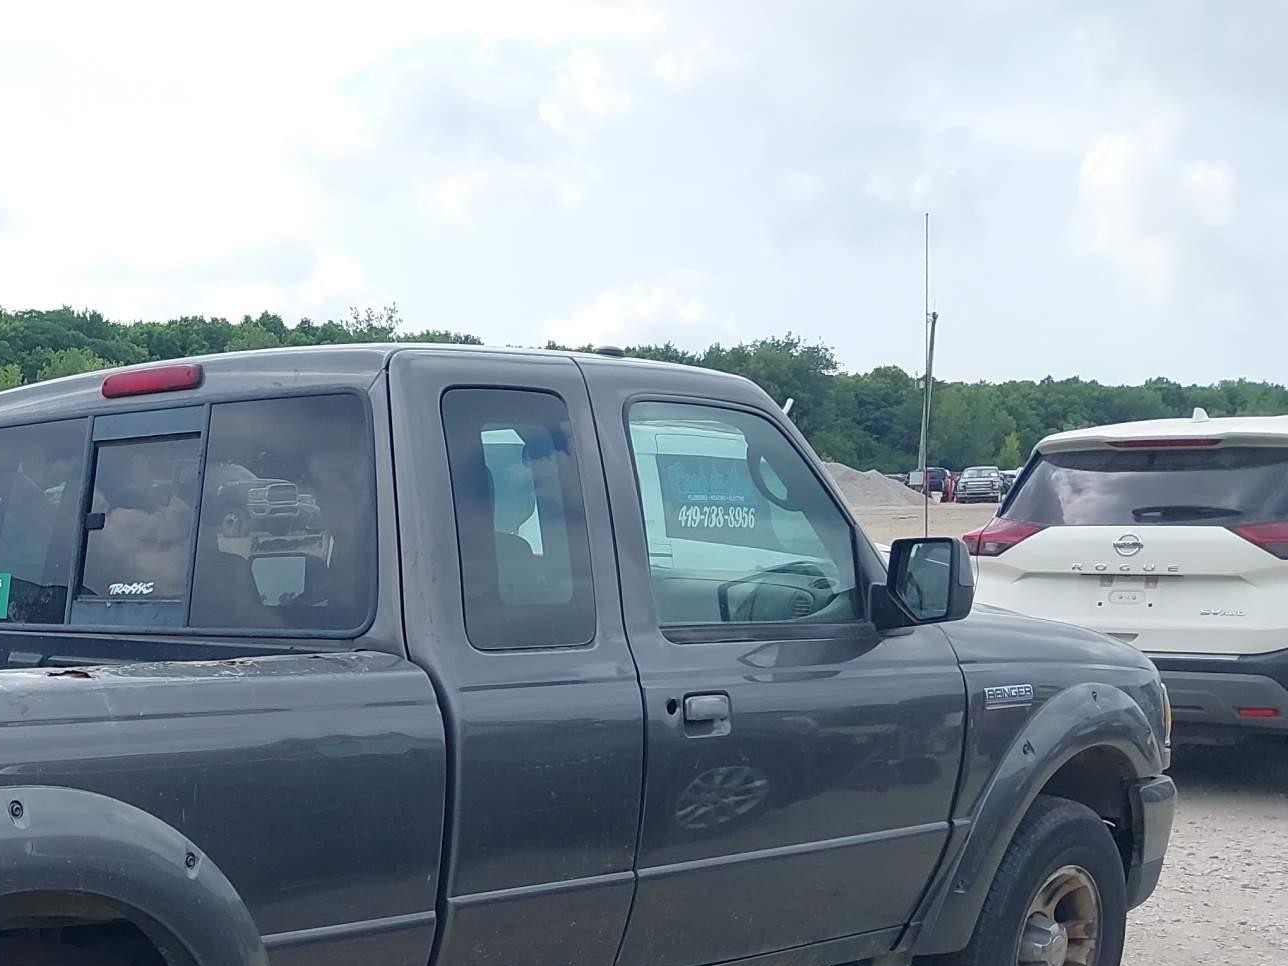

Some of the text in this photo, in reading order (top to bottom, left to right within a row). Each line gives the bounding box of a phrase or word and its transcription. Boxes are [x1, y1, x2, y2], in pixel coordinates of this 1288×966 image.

[678, 505, 756, 528] 419-738-8956
[1072, 562, 1180, 572] ROGUE
[985, 685, 1033, 700] RANGER
